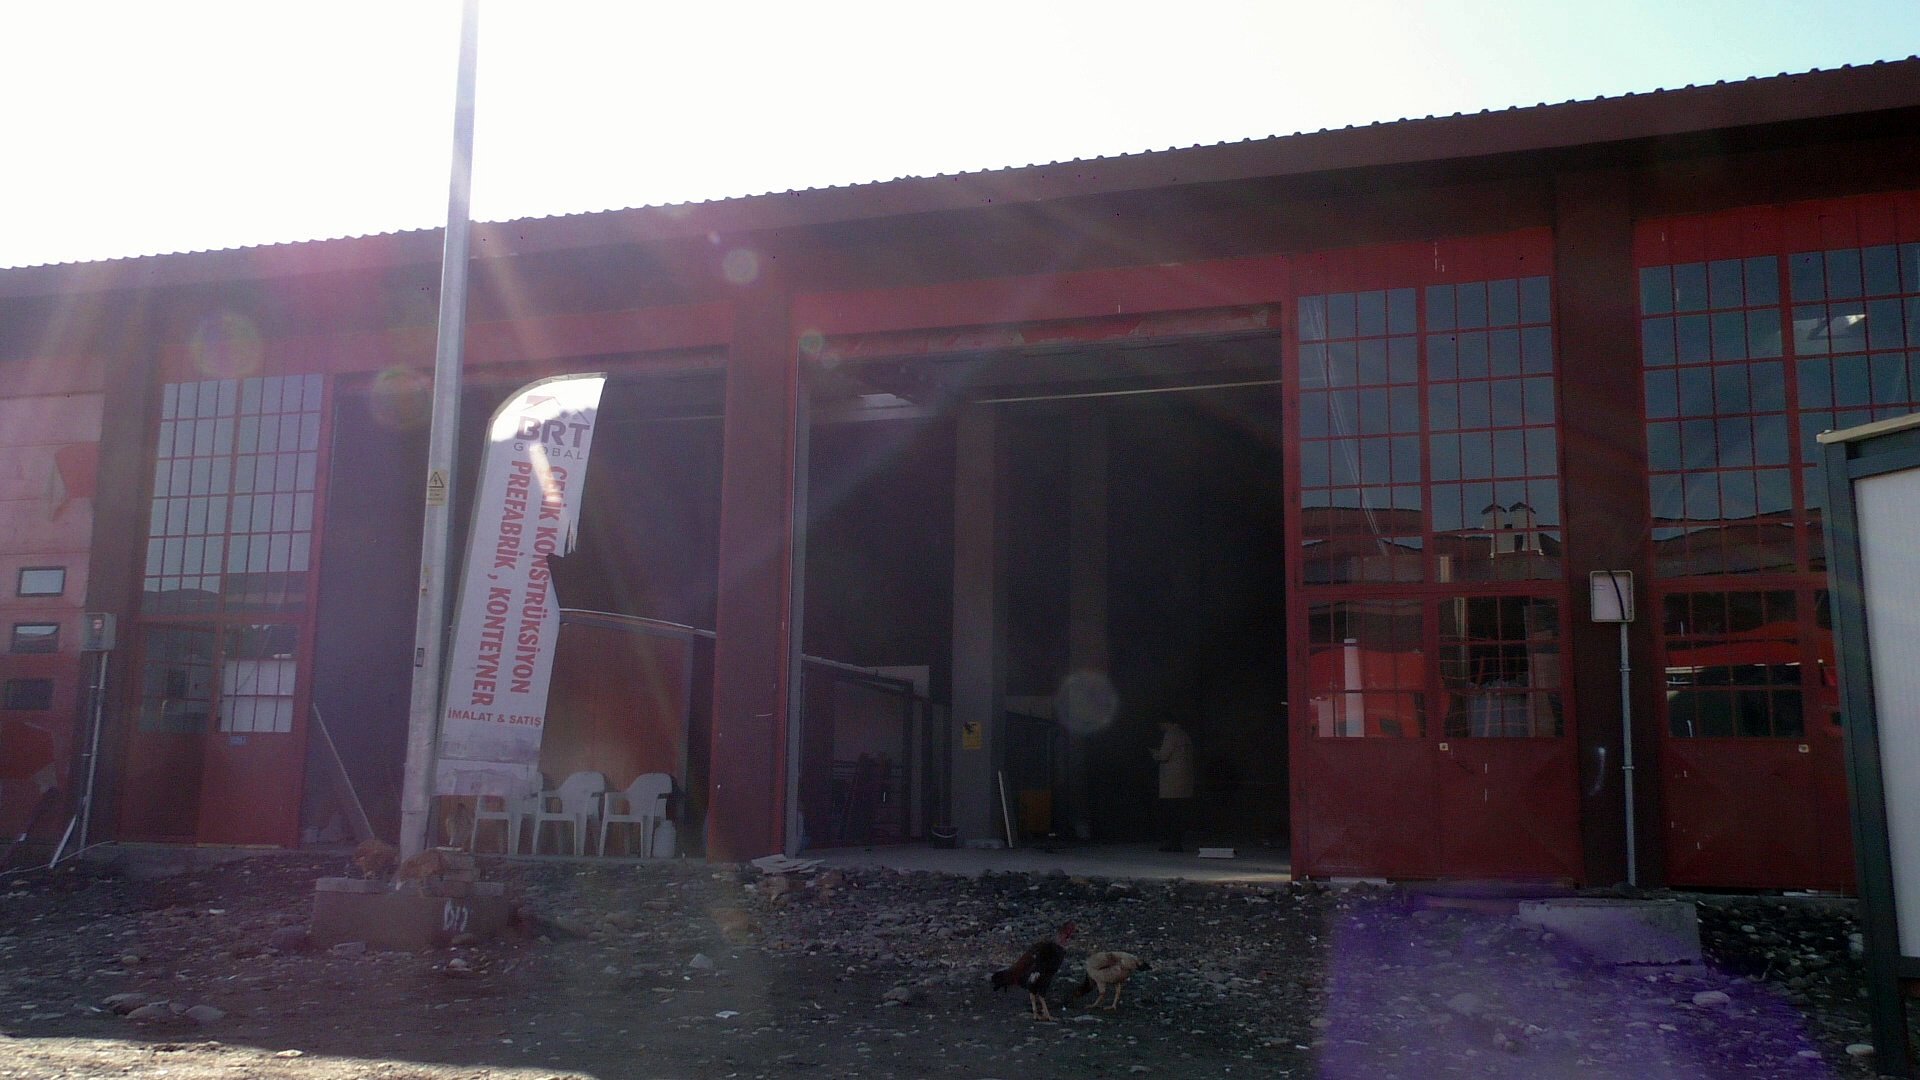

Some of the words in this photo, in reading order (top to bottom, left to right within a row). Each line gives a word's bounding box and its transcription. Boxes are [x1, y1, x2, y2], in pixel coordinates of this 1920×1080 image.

[516, 416, 591, 449] BRT
[513, 442, 584, 461] GBAL
[510, 527, 558, 694] KONSTRÜKSİYON
[471, 587, 512, 706] KONTEYNER
[447, 707, 493, 723] İMALAT
[496, 714, 506, 723] &
[509, 715, 542, 728] SATIŞ
